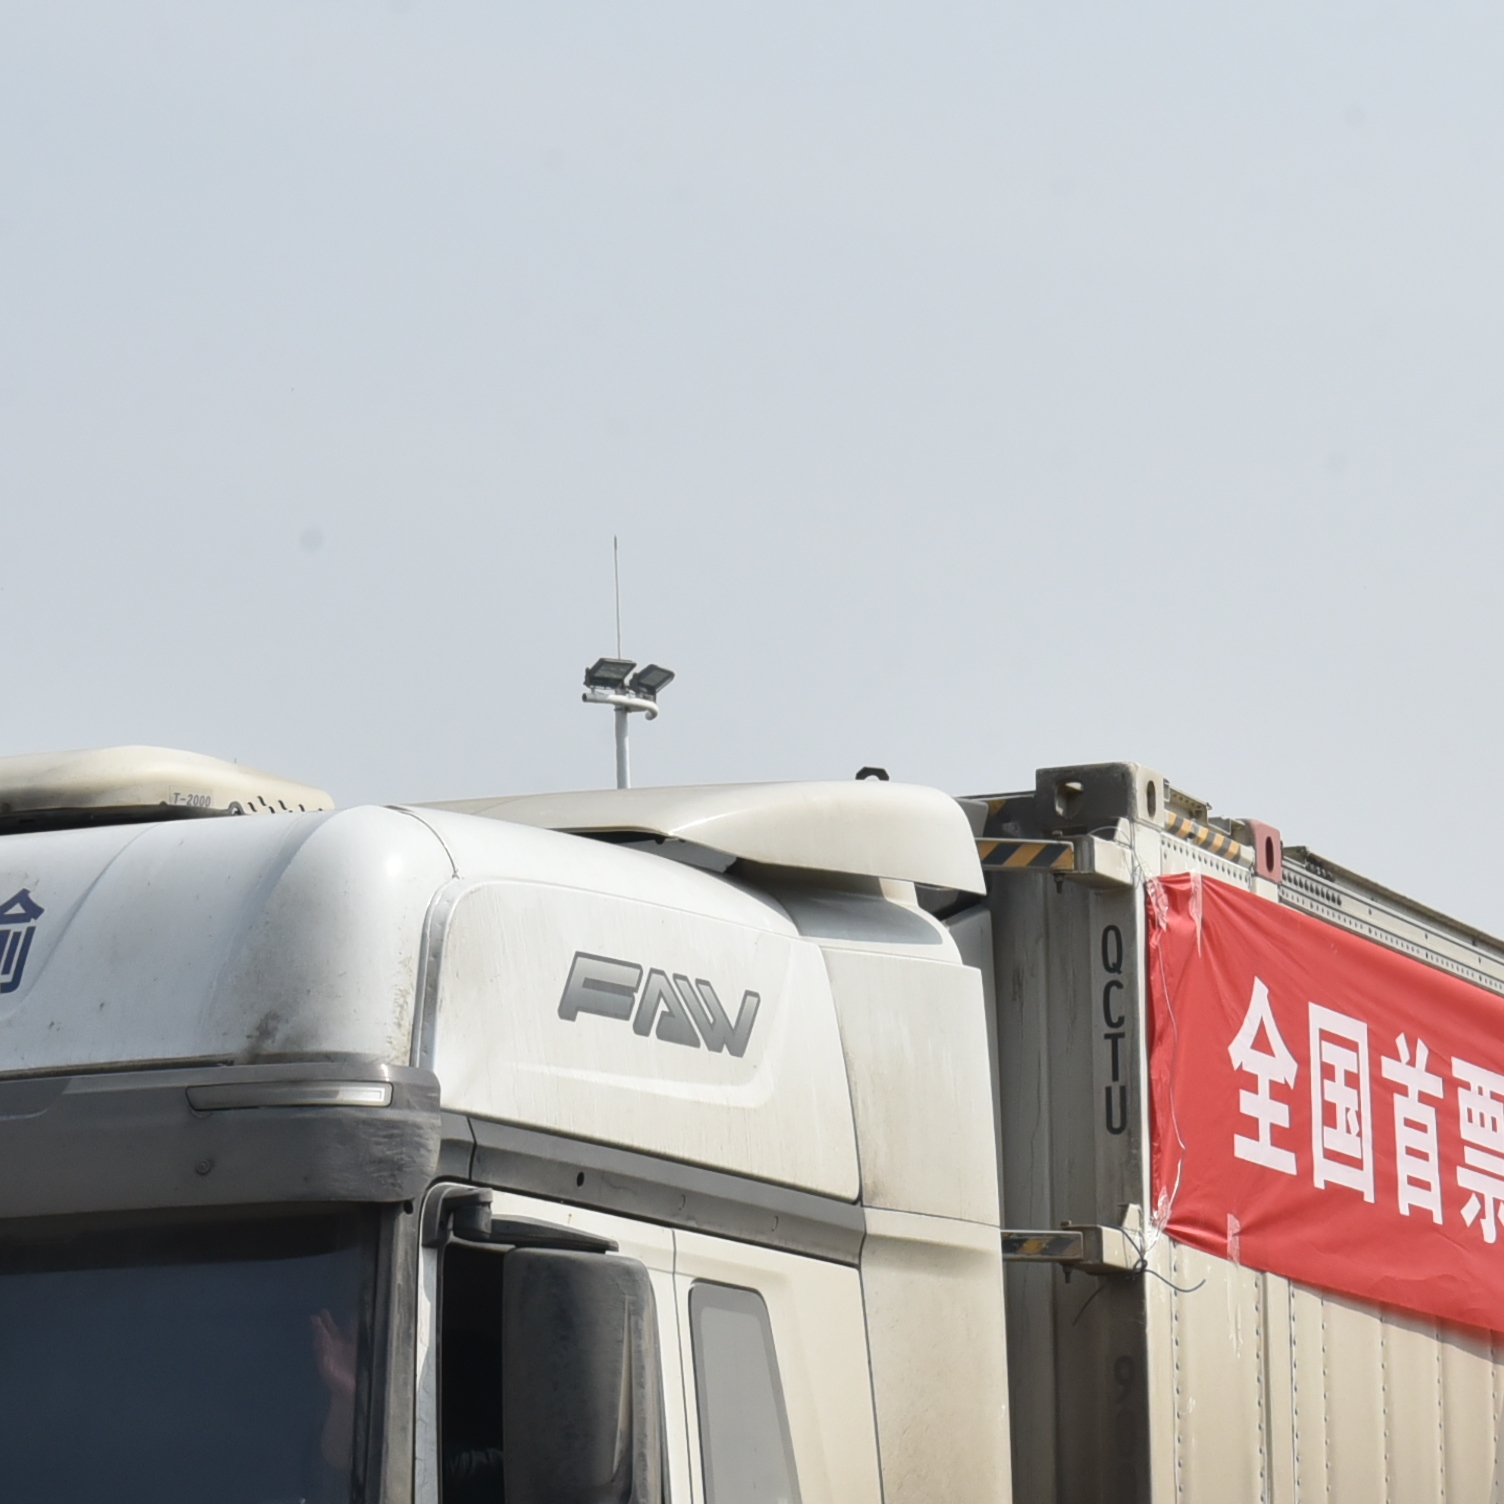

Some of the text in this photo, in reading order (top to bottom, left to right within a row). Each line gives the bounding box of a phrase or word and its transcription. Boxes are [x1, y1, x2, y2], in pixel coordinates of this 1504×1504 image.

[173, 791, 212, 808] T-2000
[557, 951, 761, 1058] FAW
[1101, 924, 1128, 1136] QCTU
